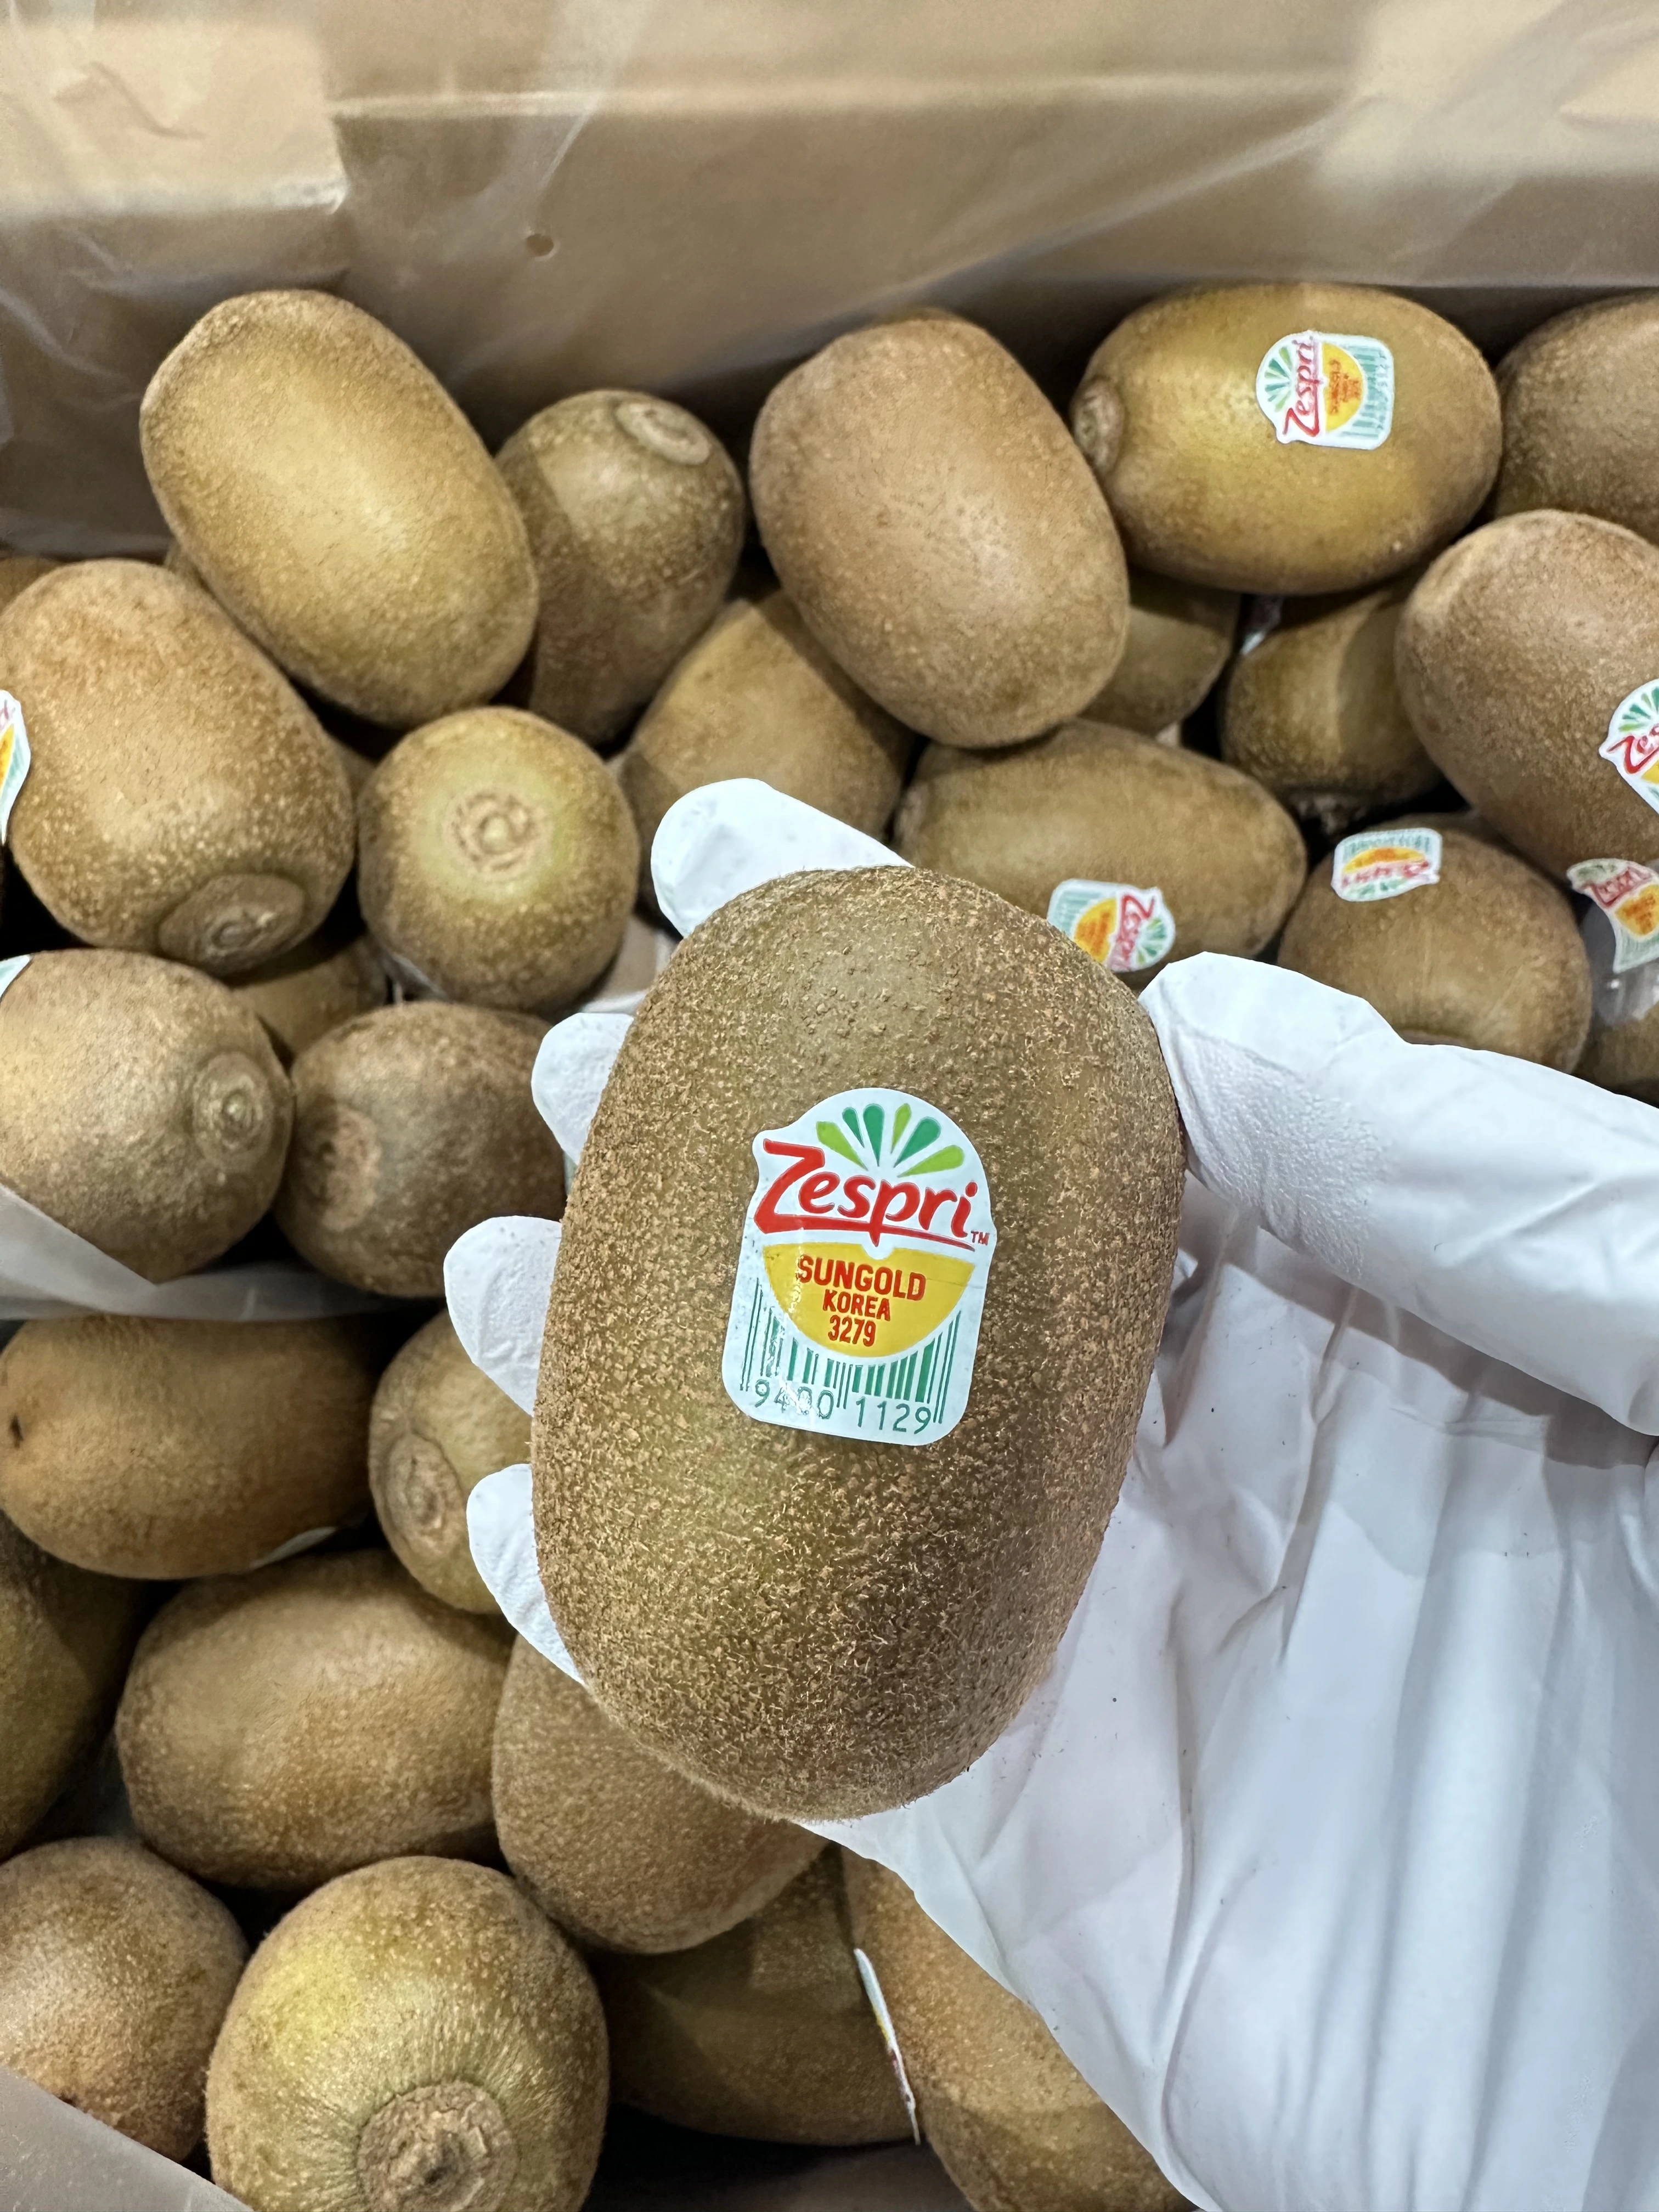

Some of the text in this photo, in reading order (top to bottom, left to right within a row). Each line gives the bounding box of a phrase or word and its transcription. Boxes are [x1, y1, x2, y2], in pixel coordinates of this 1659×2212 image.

[1282, 335, 1323, 437] Zespri
[753, 1138, 978, 1252] Zespri
[796, 1253, 927, 1301] SUNGOLD
[822, 1288, 891, 1322] KOREA
[827, 1314, 877, 1347] 3279
[855, 1395, 932, 1435] 1129
